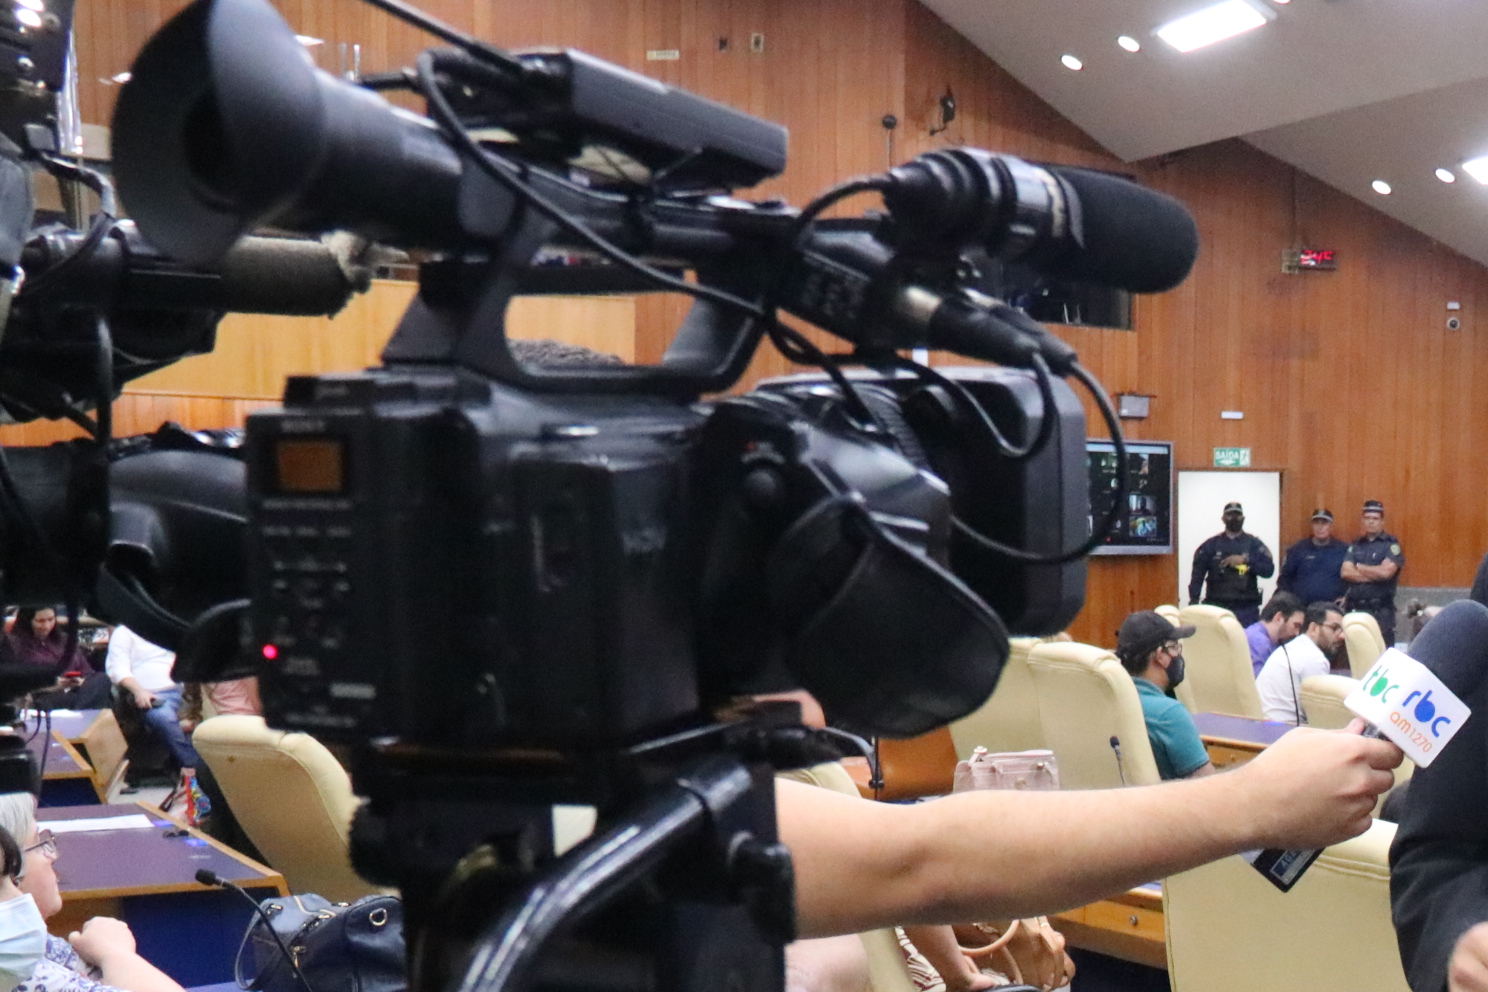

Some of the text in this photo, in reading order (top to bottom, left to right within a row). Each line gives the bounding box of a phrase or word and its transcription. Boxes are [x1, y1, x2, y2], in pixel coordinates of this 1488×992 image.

[1215, 449, 1239, 460] SAÍDA
[1362, 664, 1399, 704] tbc
[1402, 689, 1451, 738] rbc
